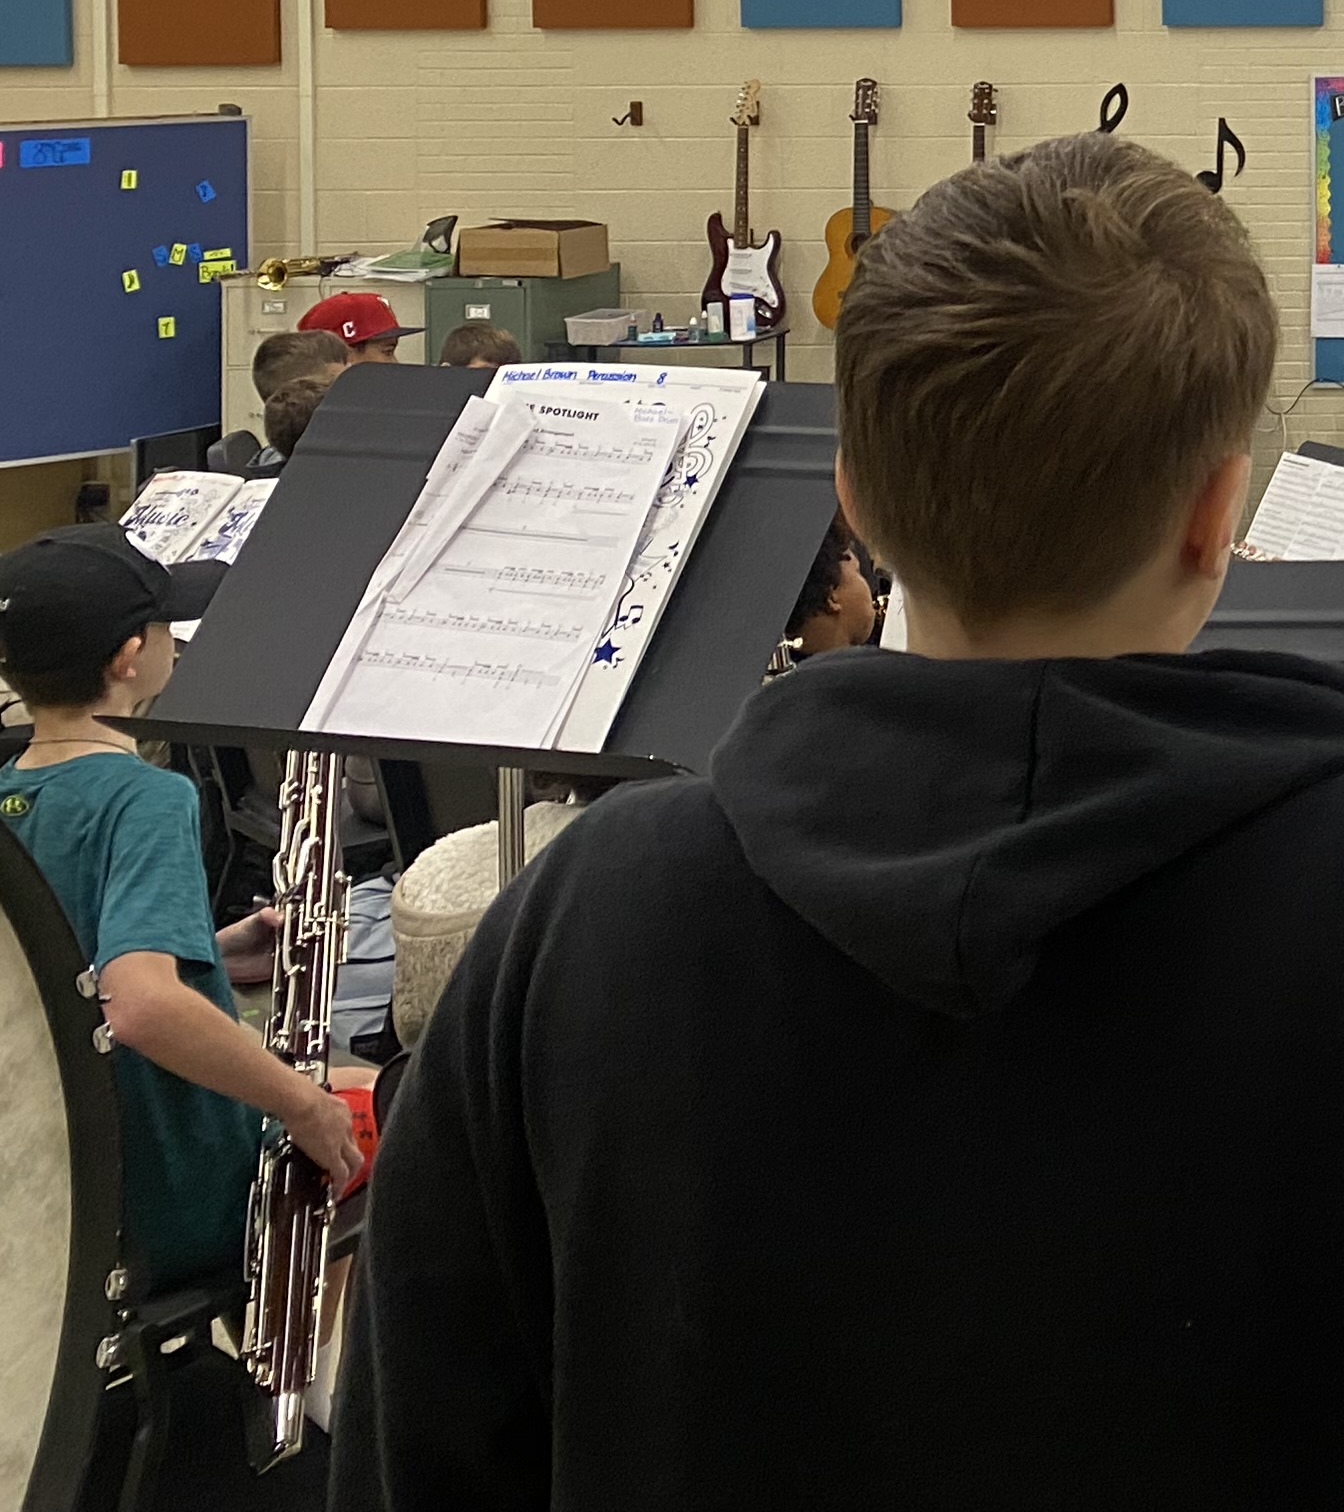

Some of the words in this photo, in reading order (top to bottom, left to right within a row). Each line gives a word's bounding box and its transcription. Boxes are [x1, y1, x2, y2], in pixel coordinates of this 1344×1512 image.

[342, 321, 356, 338] C
[502, 369, 541, 382] Michael
[542, 369, 577, 381] Brown
[587, 370, 637, 383] Percussion
[656, 372, 668, 385] 8
[540, 405, 600, 422] SPOTLIGHT
